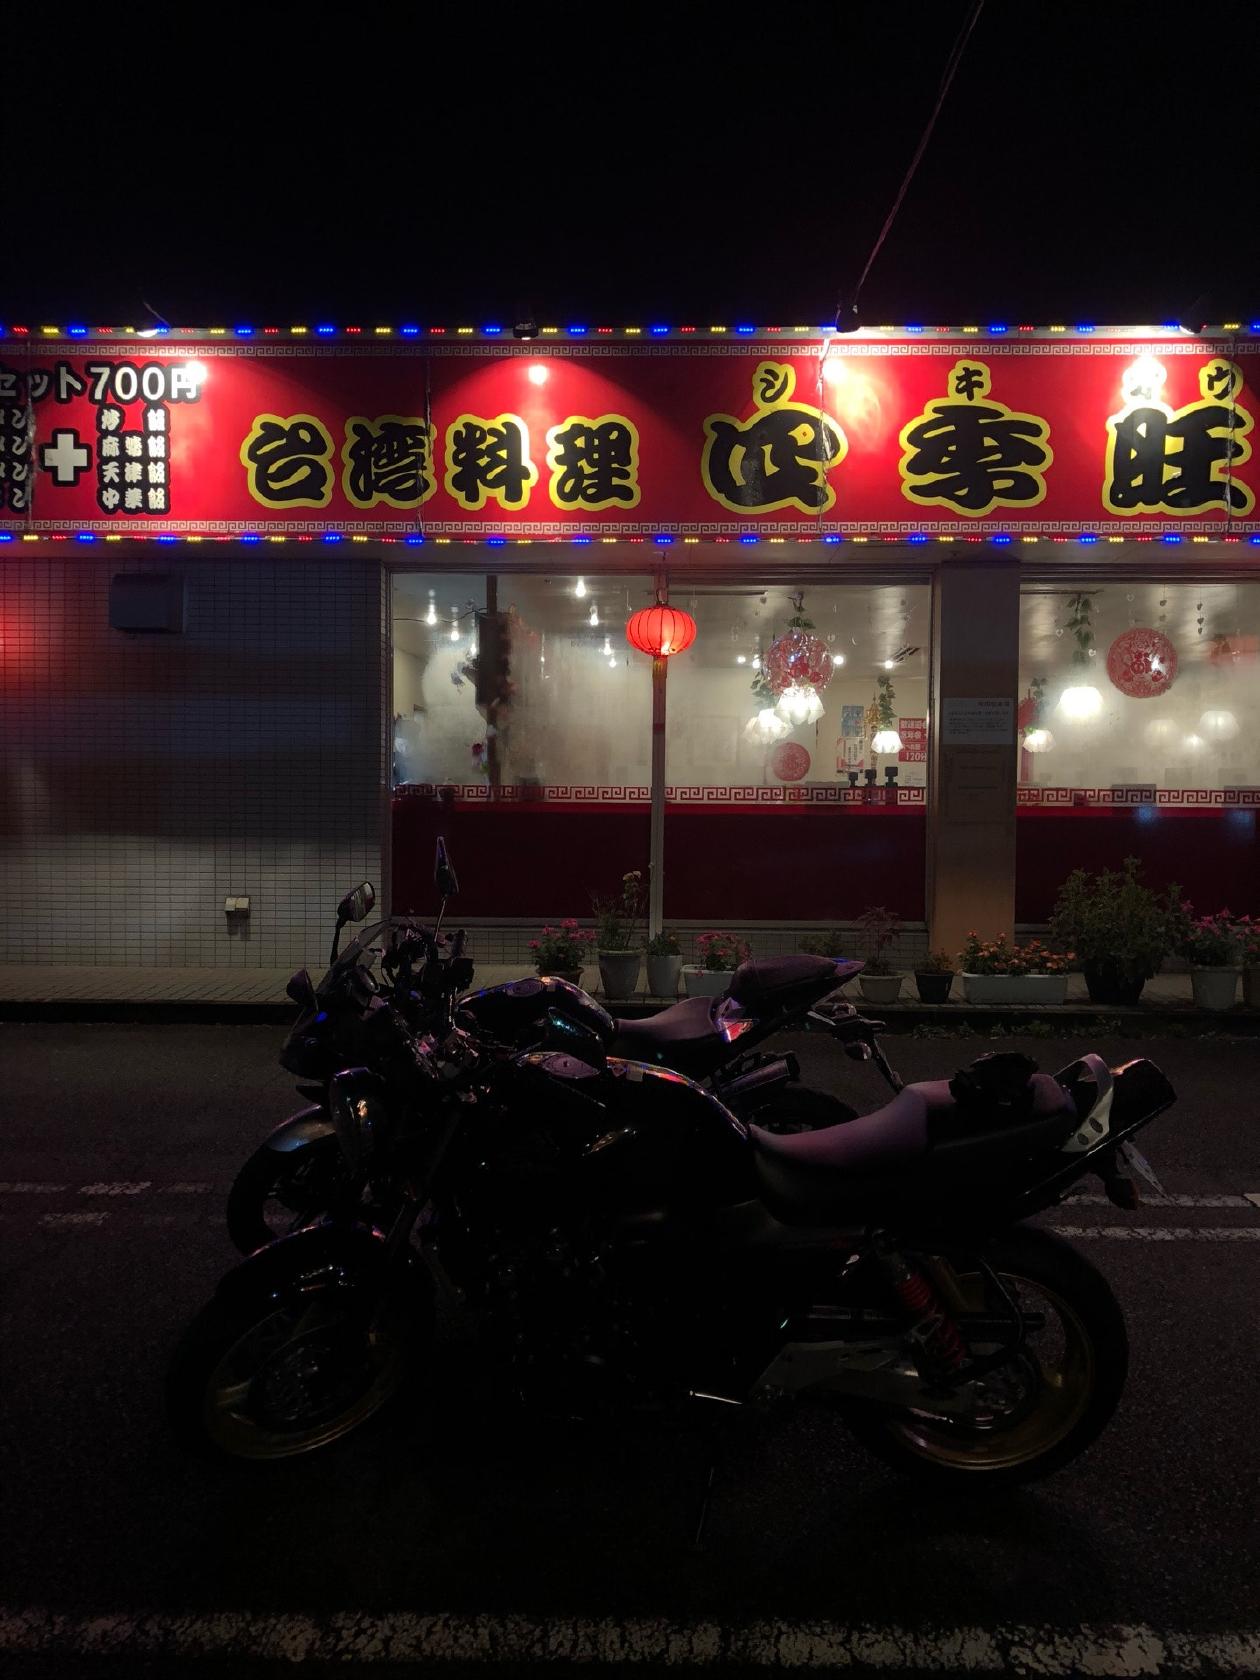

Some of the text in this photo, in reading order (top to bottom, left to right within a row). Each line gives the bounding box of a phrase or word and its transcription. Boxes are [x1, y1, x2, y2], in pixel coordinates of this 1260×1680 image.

[101, 461, 166, 484] 天津飯
[101, 487, 166, 510] 中華飯
